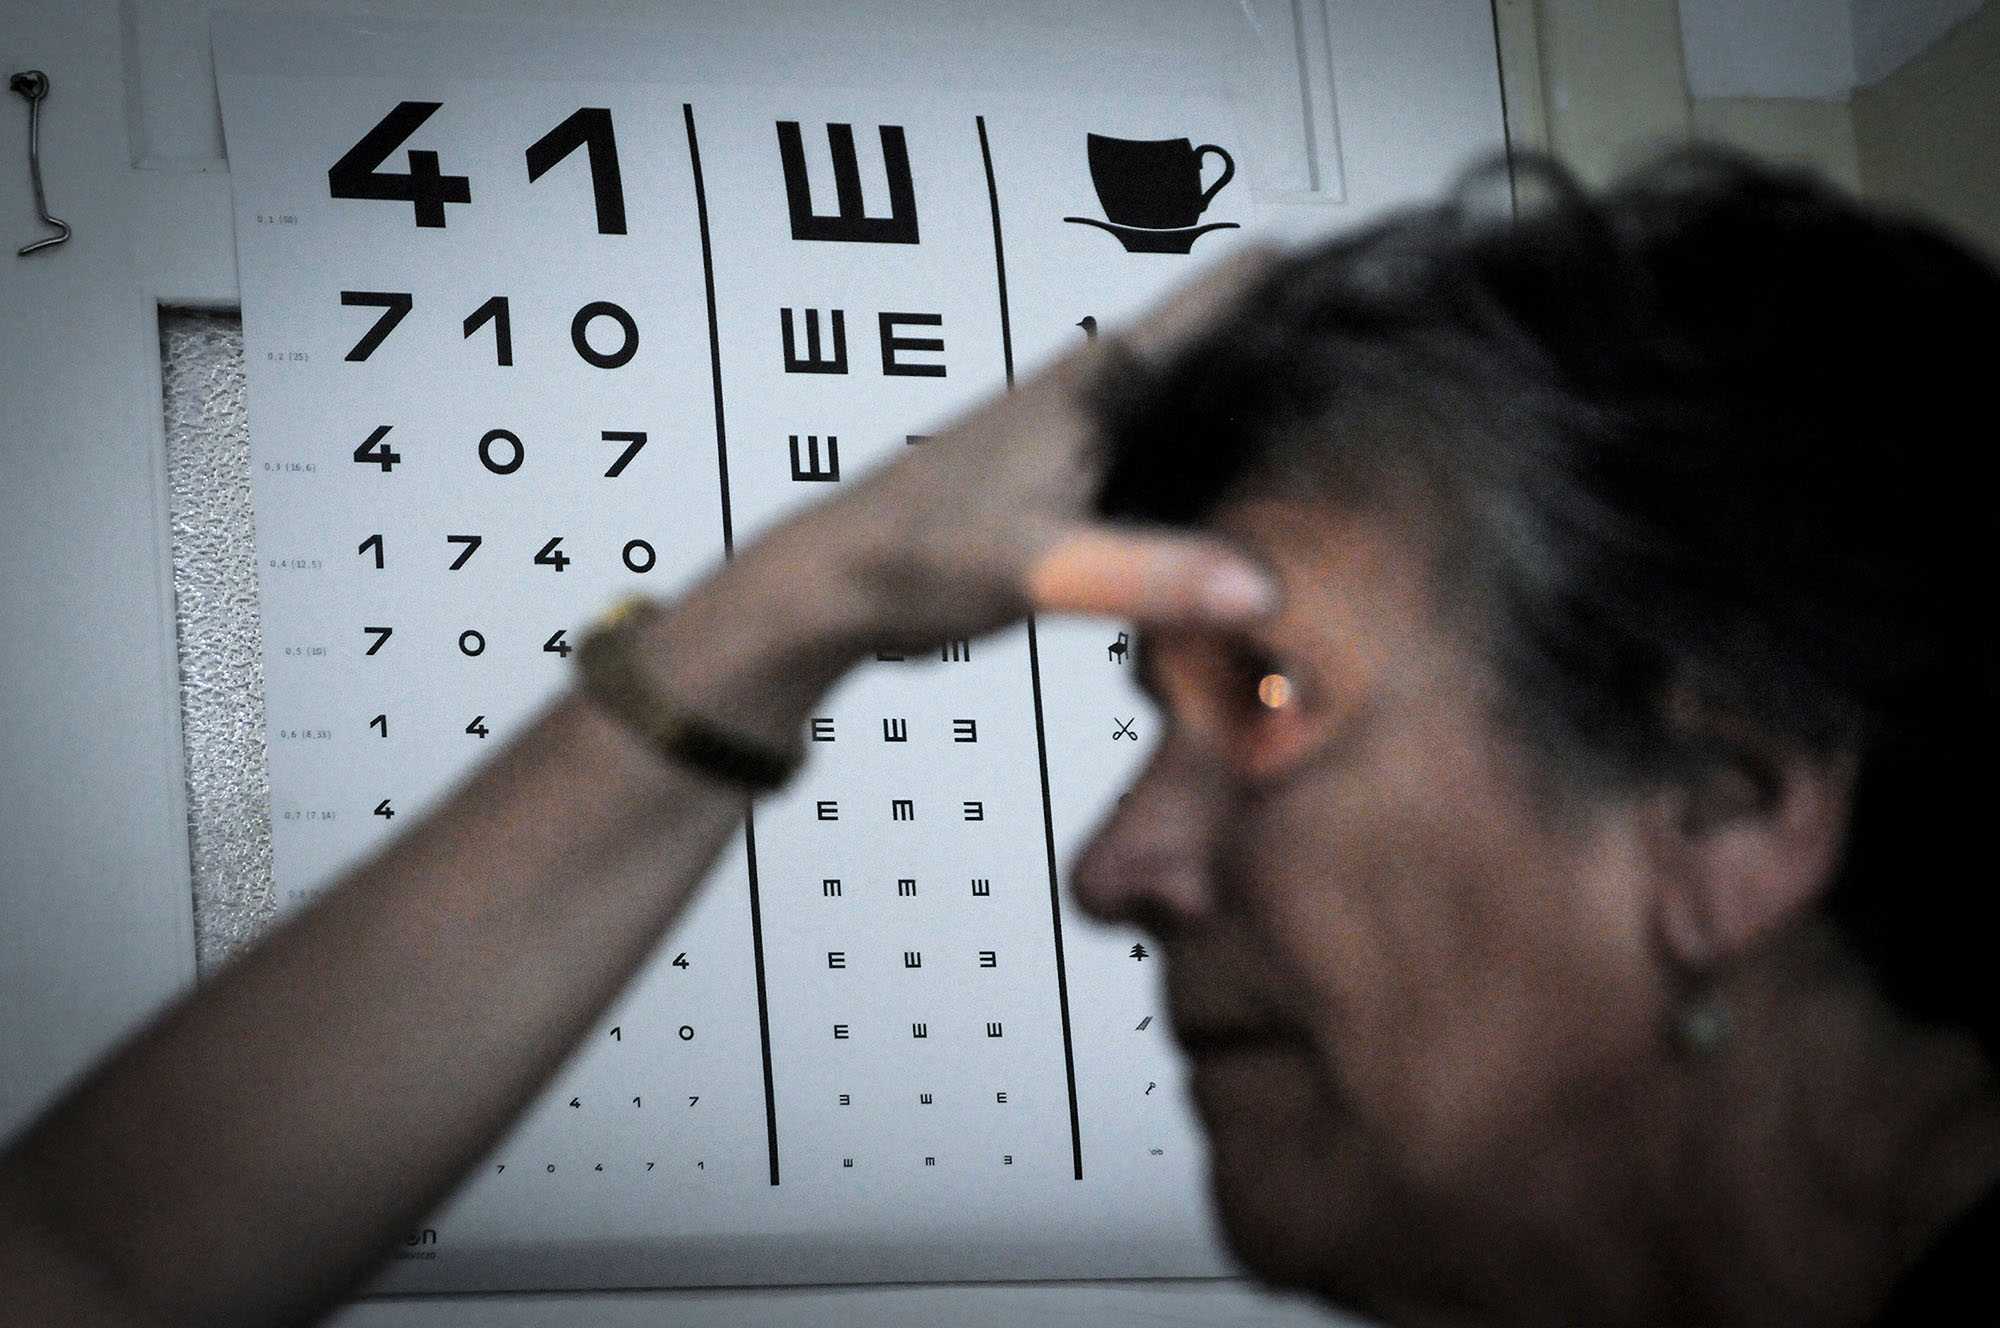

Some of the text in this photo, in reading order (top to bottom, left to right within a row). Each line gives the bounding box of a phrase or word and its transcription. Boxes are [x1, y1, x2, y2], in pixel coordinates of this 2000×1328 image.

[341, 291, 640, 369] 7 1 0
[878, 312, 946, 377] E
[354, 426, 647, 477] 4 0 7
[359, 535, 656, 573] 1 7 4 0
[365, 627, 572, 657] 7 0 4
[370, 715, 489, 738] 1 4
[811, 718, 835, 742] E
[374, 800, 394, 819] 4
[817, 801, 838, 820] E
[673, 953, 690, 969] 4
[828, 952, 845, 968] E
[610, 1026, 694, 1041] 1 0
[834, 1025, 849, 1039] E
[569, 1097, 699, 1109] 4 1 7
[997, 1092, 1007, 1103] E
[497, 1162, 704, 1174] 7 0 4 7 1
